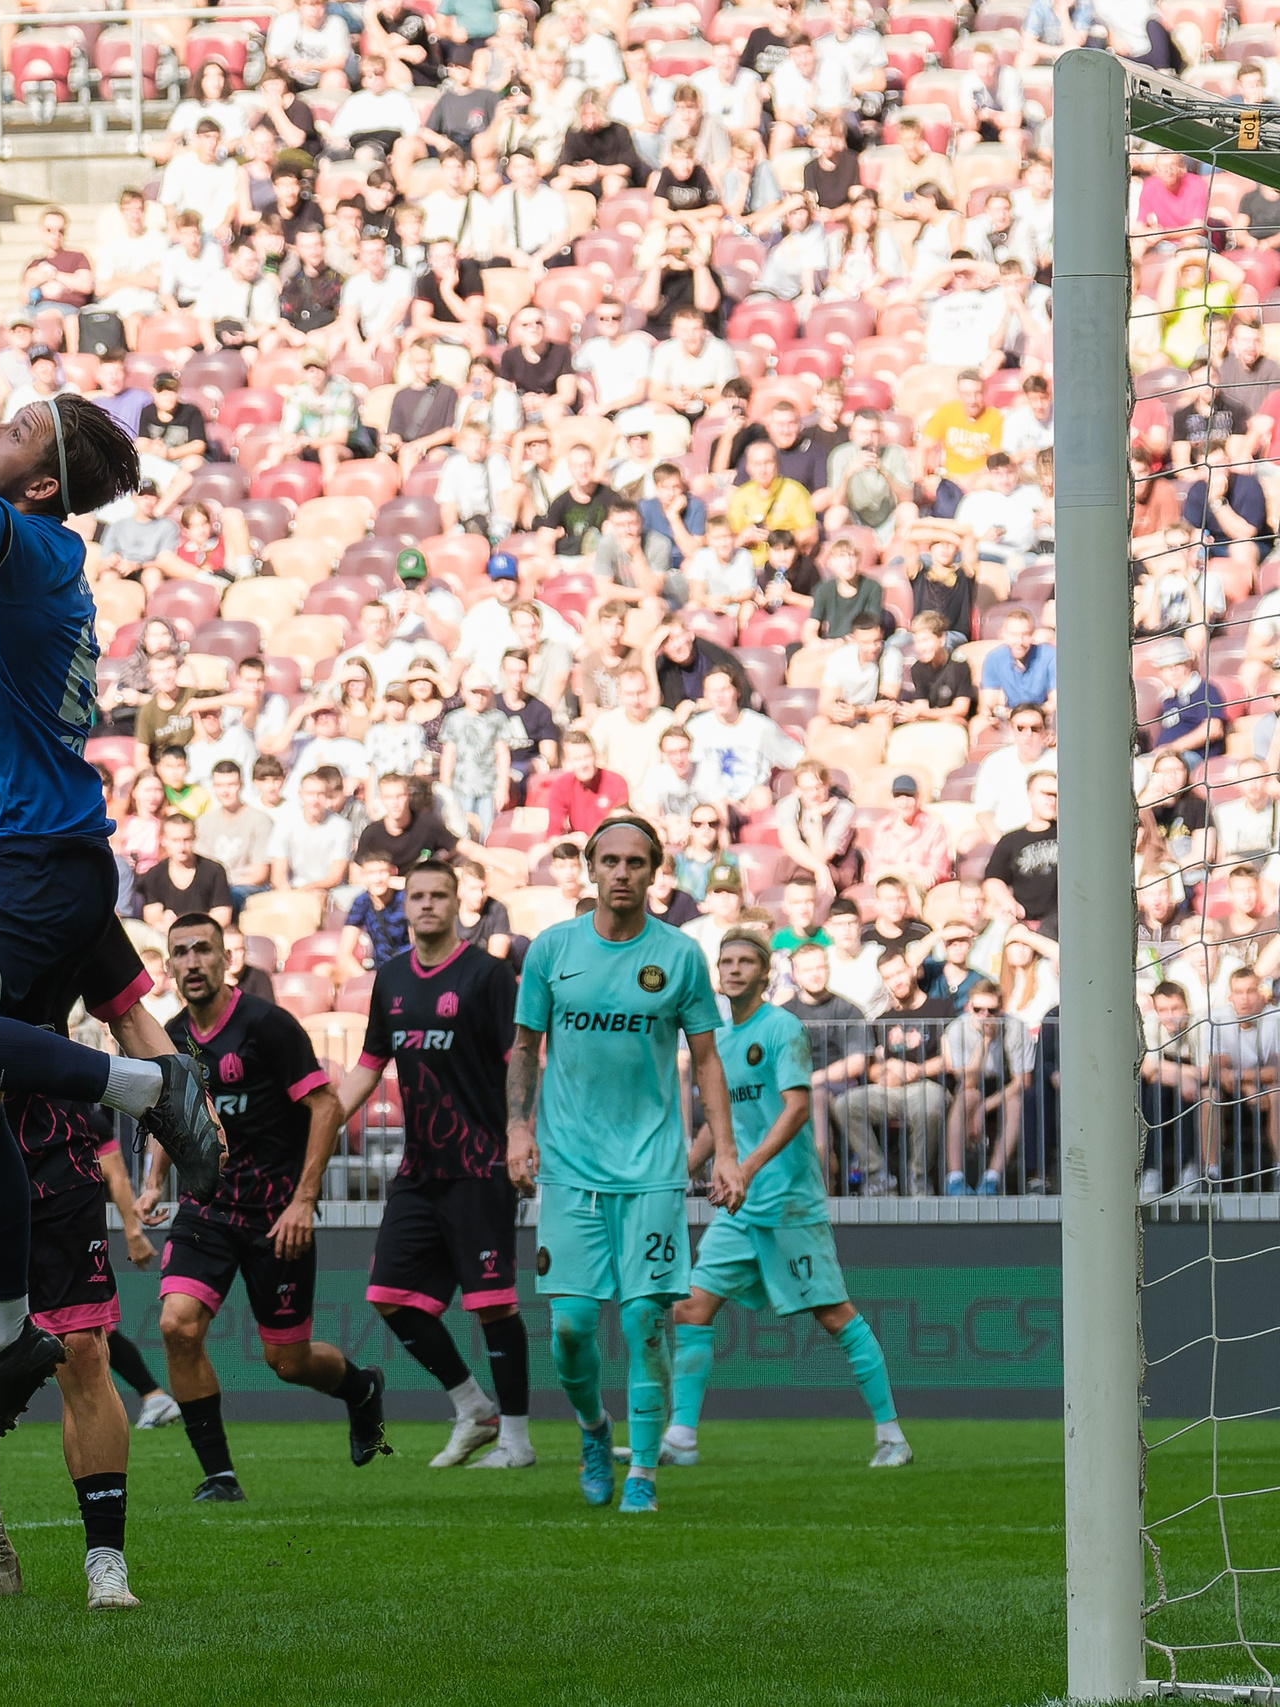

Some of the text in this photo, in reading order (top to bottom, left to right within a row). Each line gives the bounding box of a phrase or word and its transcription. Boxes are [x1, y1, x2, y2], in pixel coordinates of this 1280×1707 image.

[1243, 113, 1258, 141] TOP
[564, 1011, 659, 1035] FONBET
[391, 1029, 455, 1051] PARI
[214, 1092, 249, 1116] RI
[645, 1232, 676, 1263] 26
